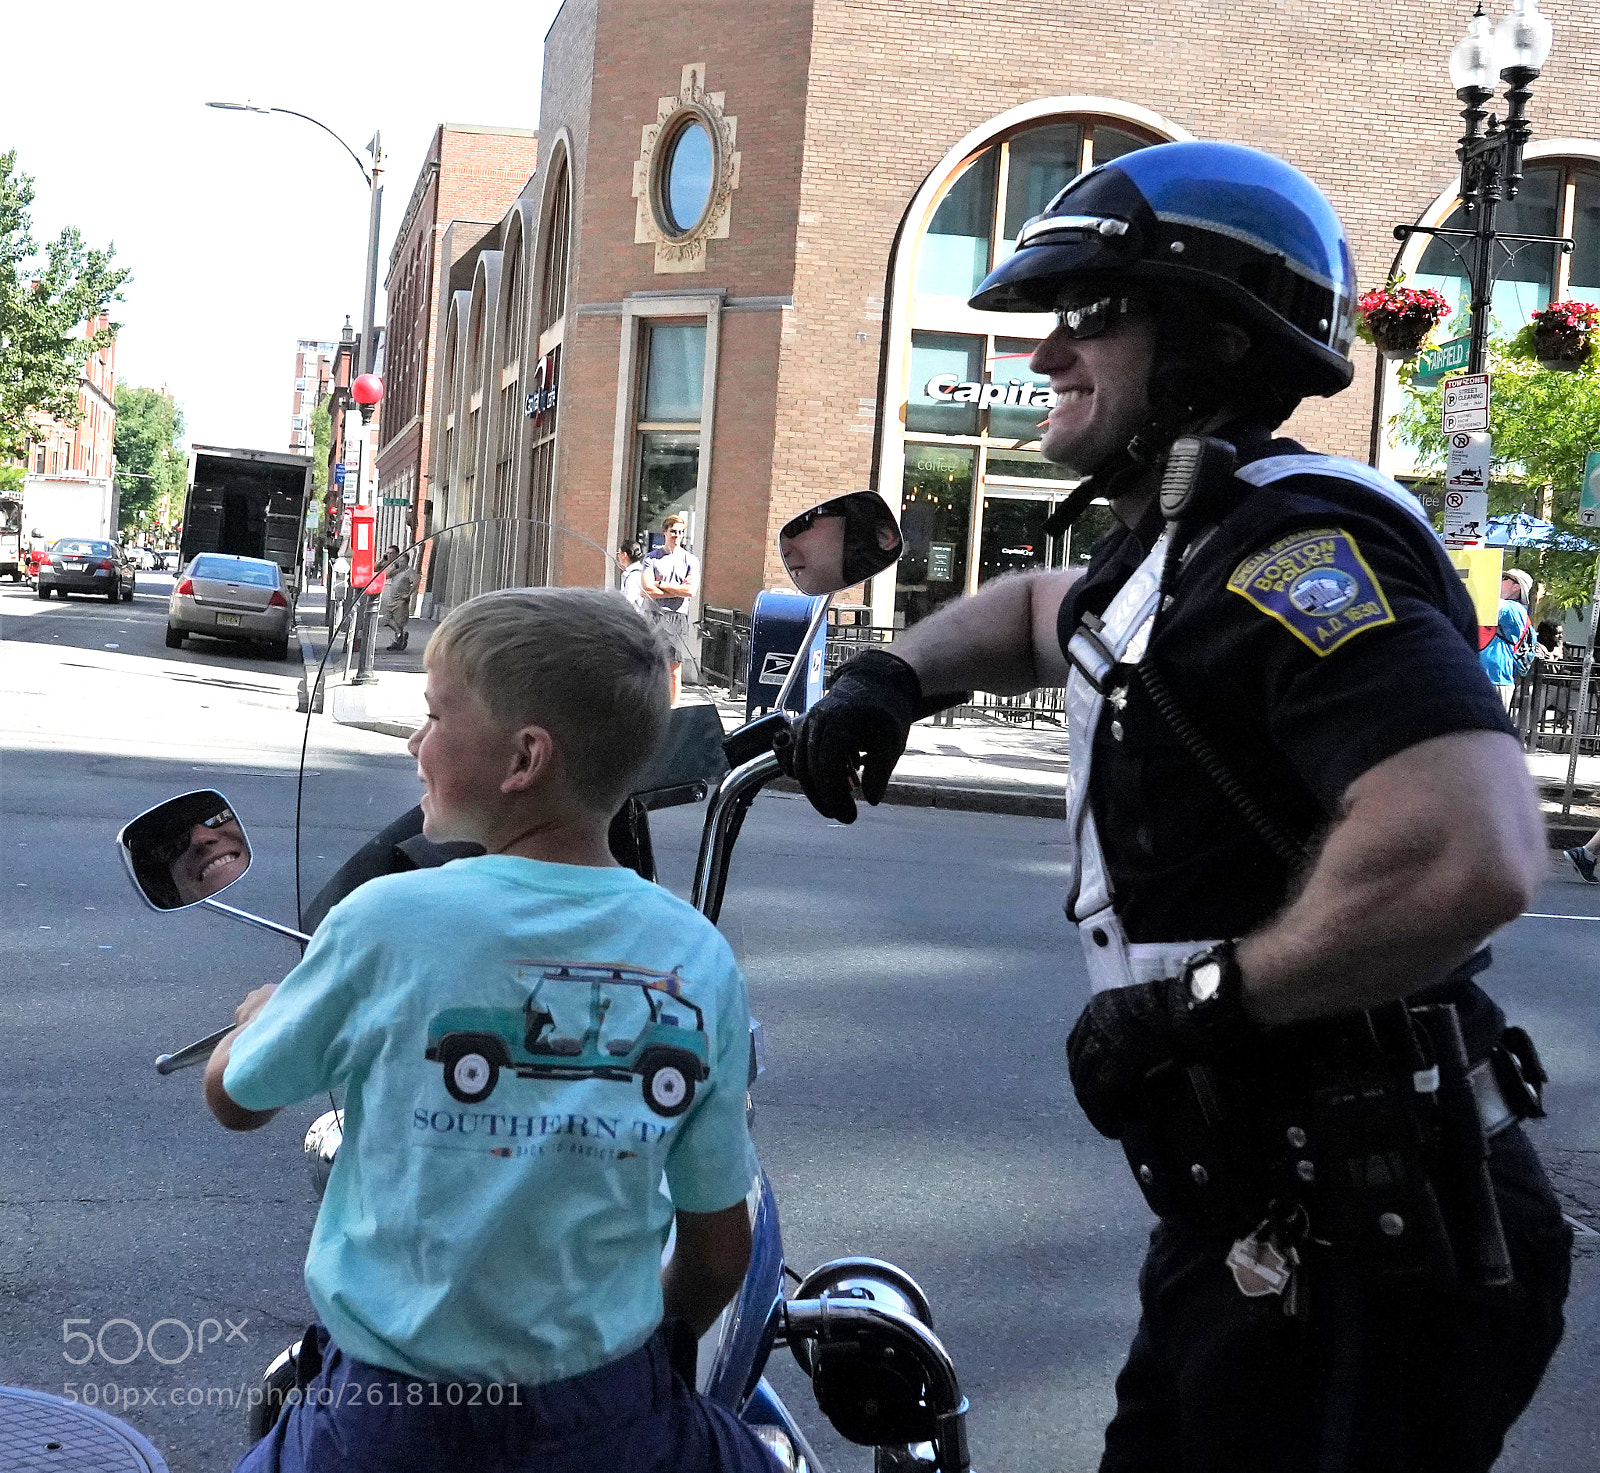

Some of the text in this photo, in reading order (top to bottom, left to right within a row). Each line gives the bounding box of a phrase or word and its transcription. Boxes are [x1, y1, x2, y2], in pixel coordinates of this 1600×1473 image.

[1428, 344, 1463, 371] FAIRFIELD
[926, 373, 1058, 409] Capita
[1458, 392, 1484, 401] CLEANING
[1418, 493, 1440, 507] ffee
[1253, 540, 1335, 592] BOSTON
[1272, 552, 1335, 592] POLICE
[413, 1108, 620, 1139] SOUTHERN
